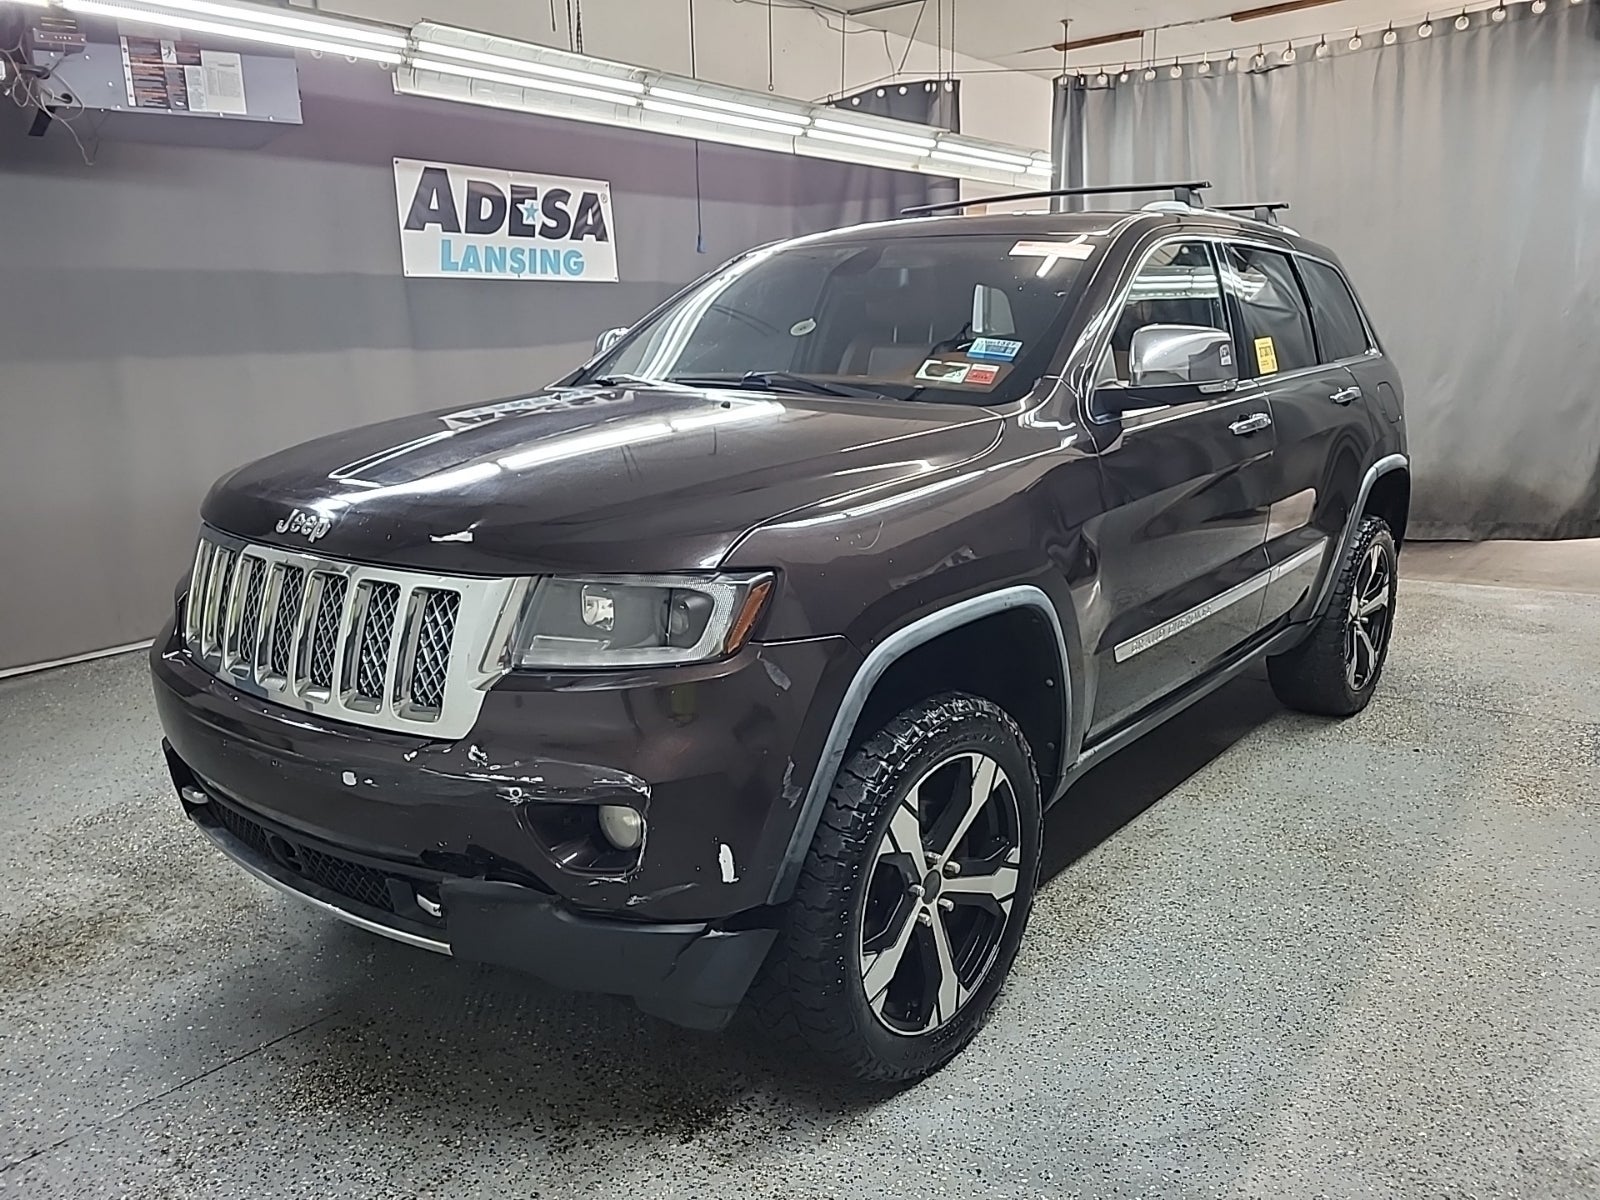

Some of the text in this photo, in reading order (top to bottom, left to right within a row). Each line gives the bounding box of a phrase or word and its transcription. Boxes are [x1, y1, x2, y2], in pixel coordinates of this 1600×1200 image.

[404, 166, 609, 242] ADESA
[441, 239, 585, 276] LANSING
[276, 508, 331, 543] Jeep
